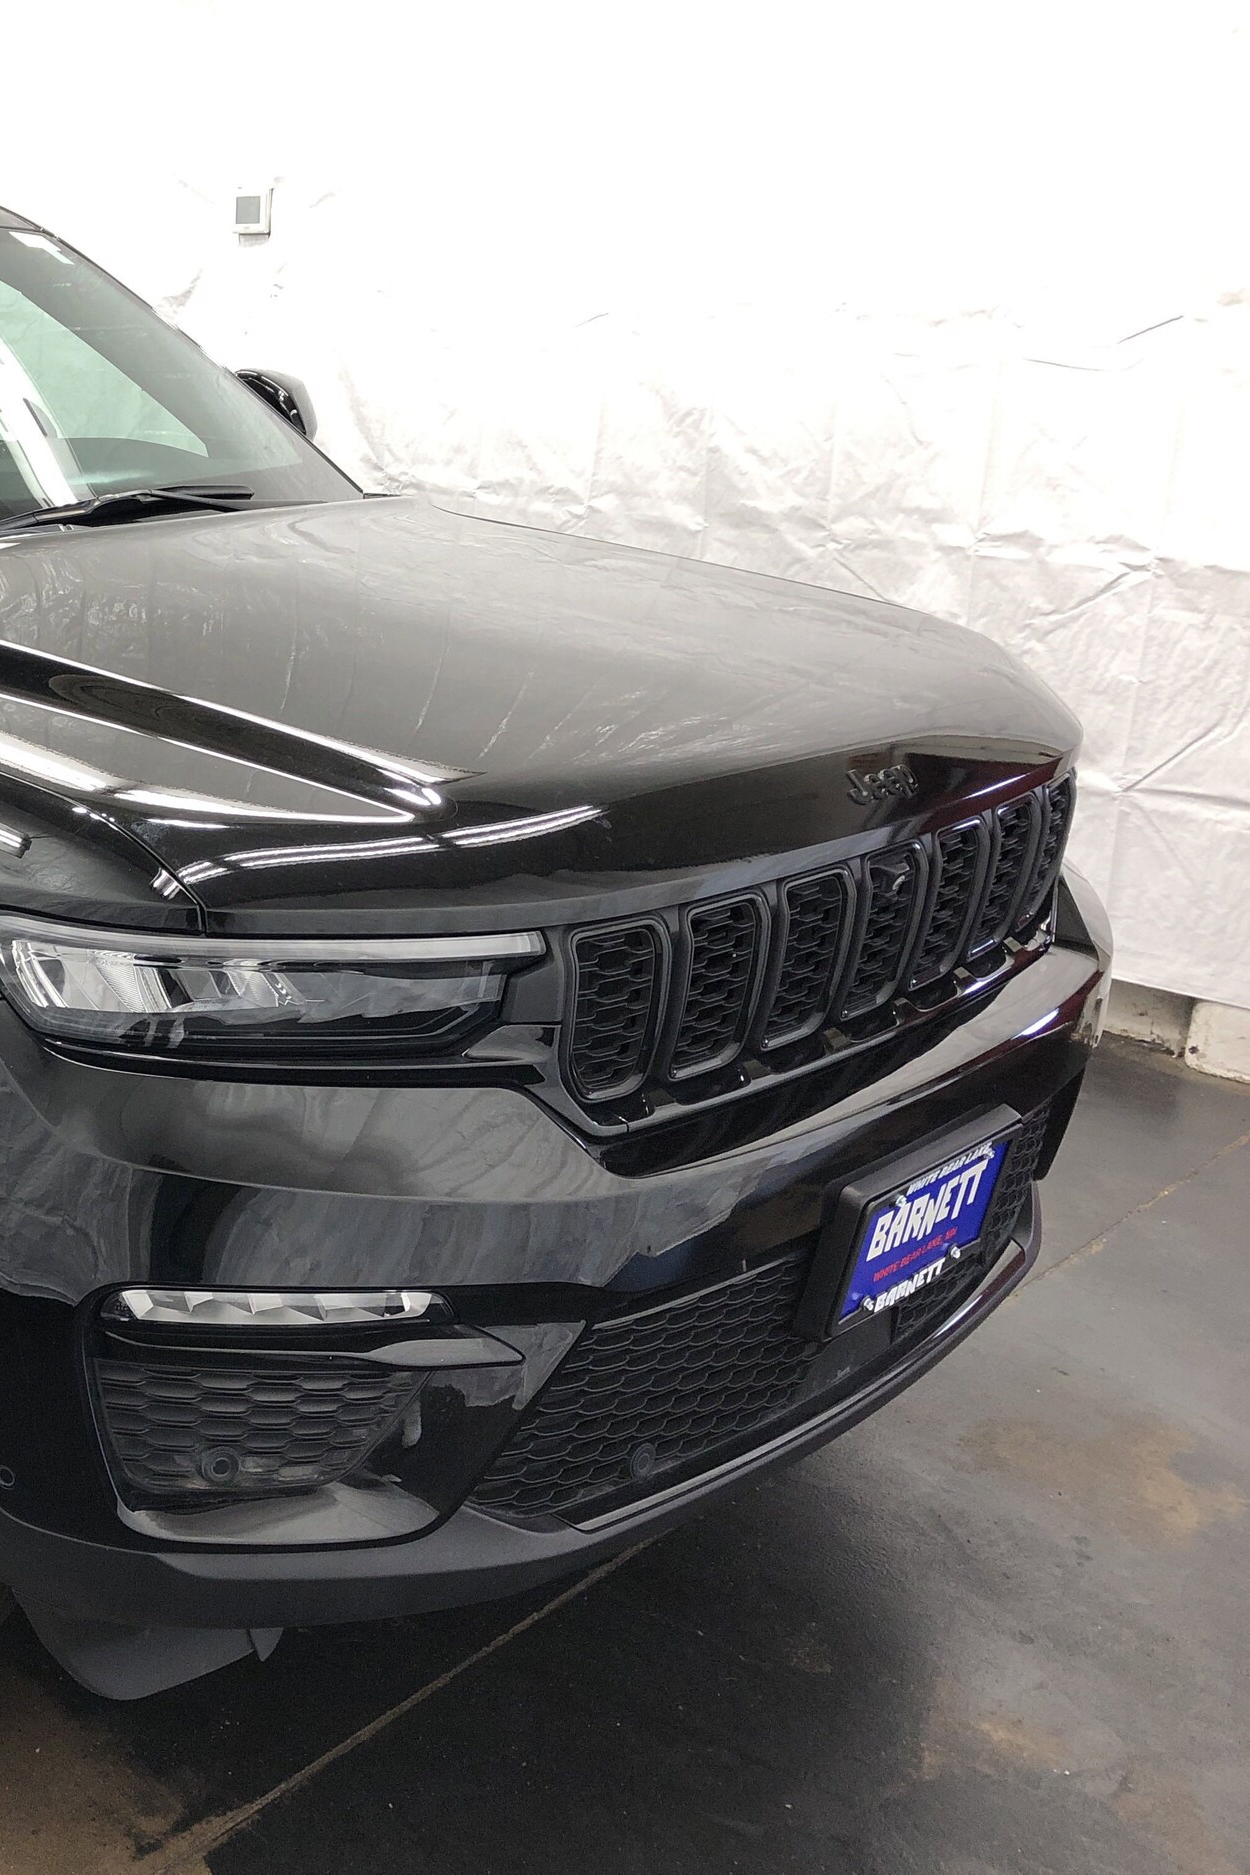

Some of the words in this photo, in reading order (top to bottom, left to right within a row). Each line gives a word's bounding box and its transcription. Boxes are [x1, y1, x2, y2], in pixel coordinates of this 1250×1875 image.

[847, 764, 918, 806] Jeep
[906, 1169, 941, 1196] WHITE
[938, 1156, 967, 1179] BEAR
[866, 1159, 989, 1262] BARNETT
[874, 1257, 946, 1312] BARNETT
